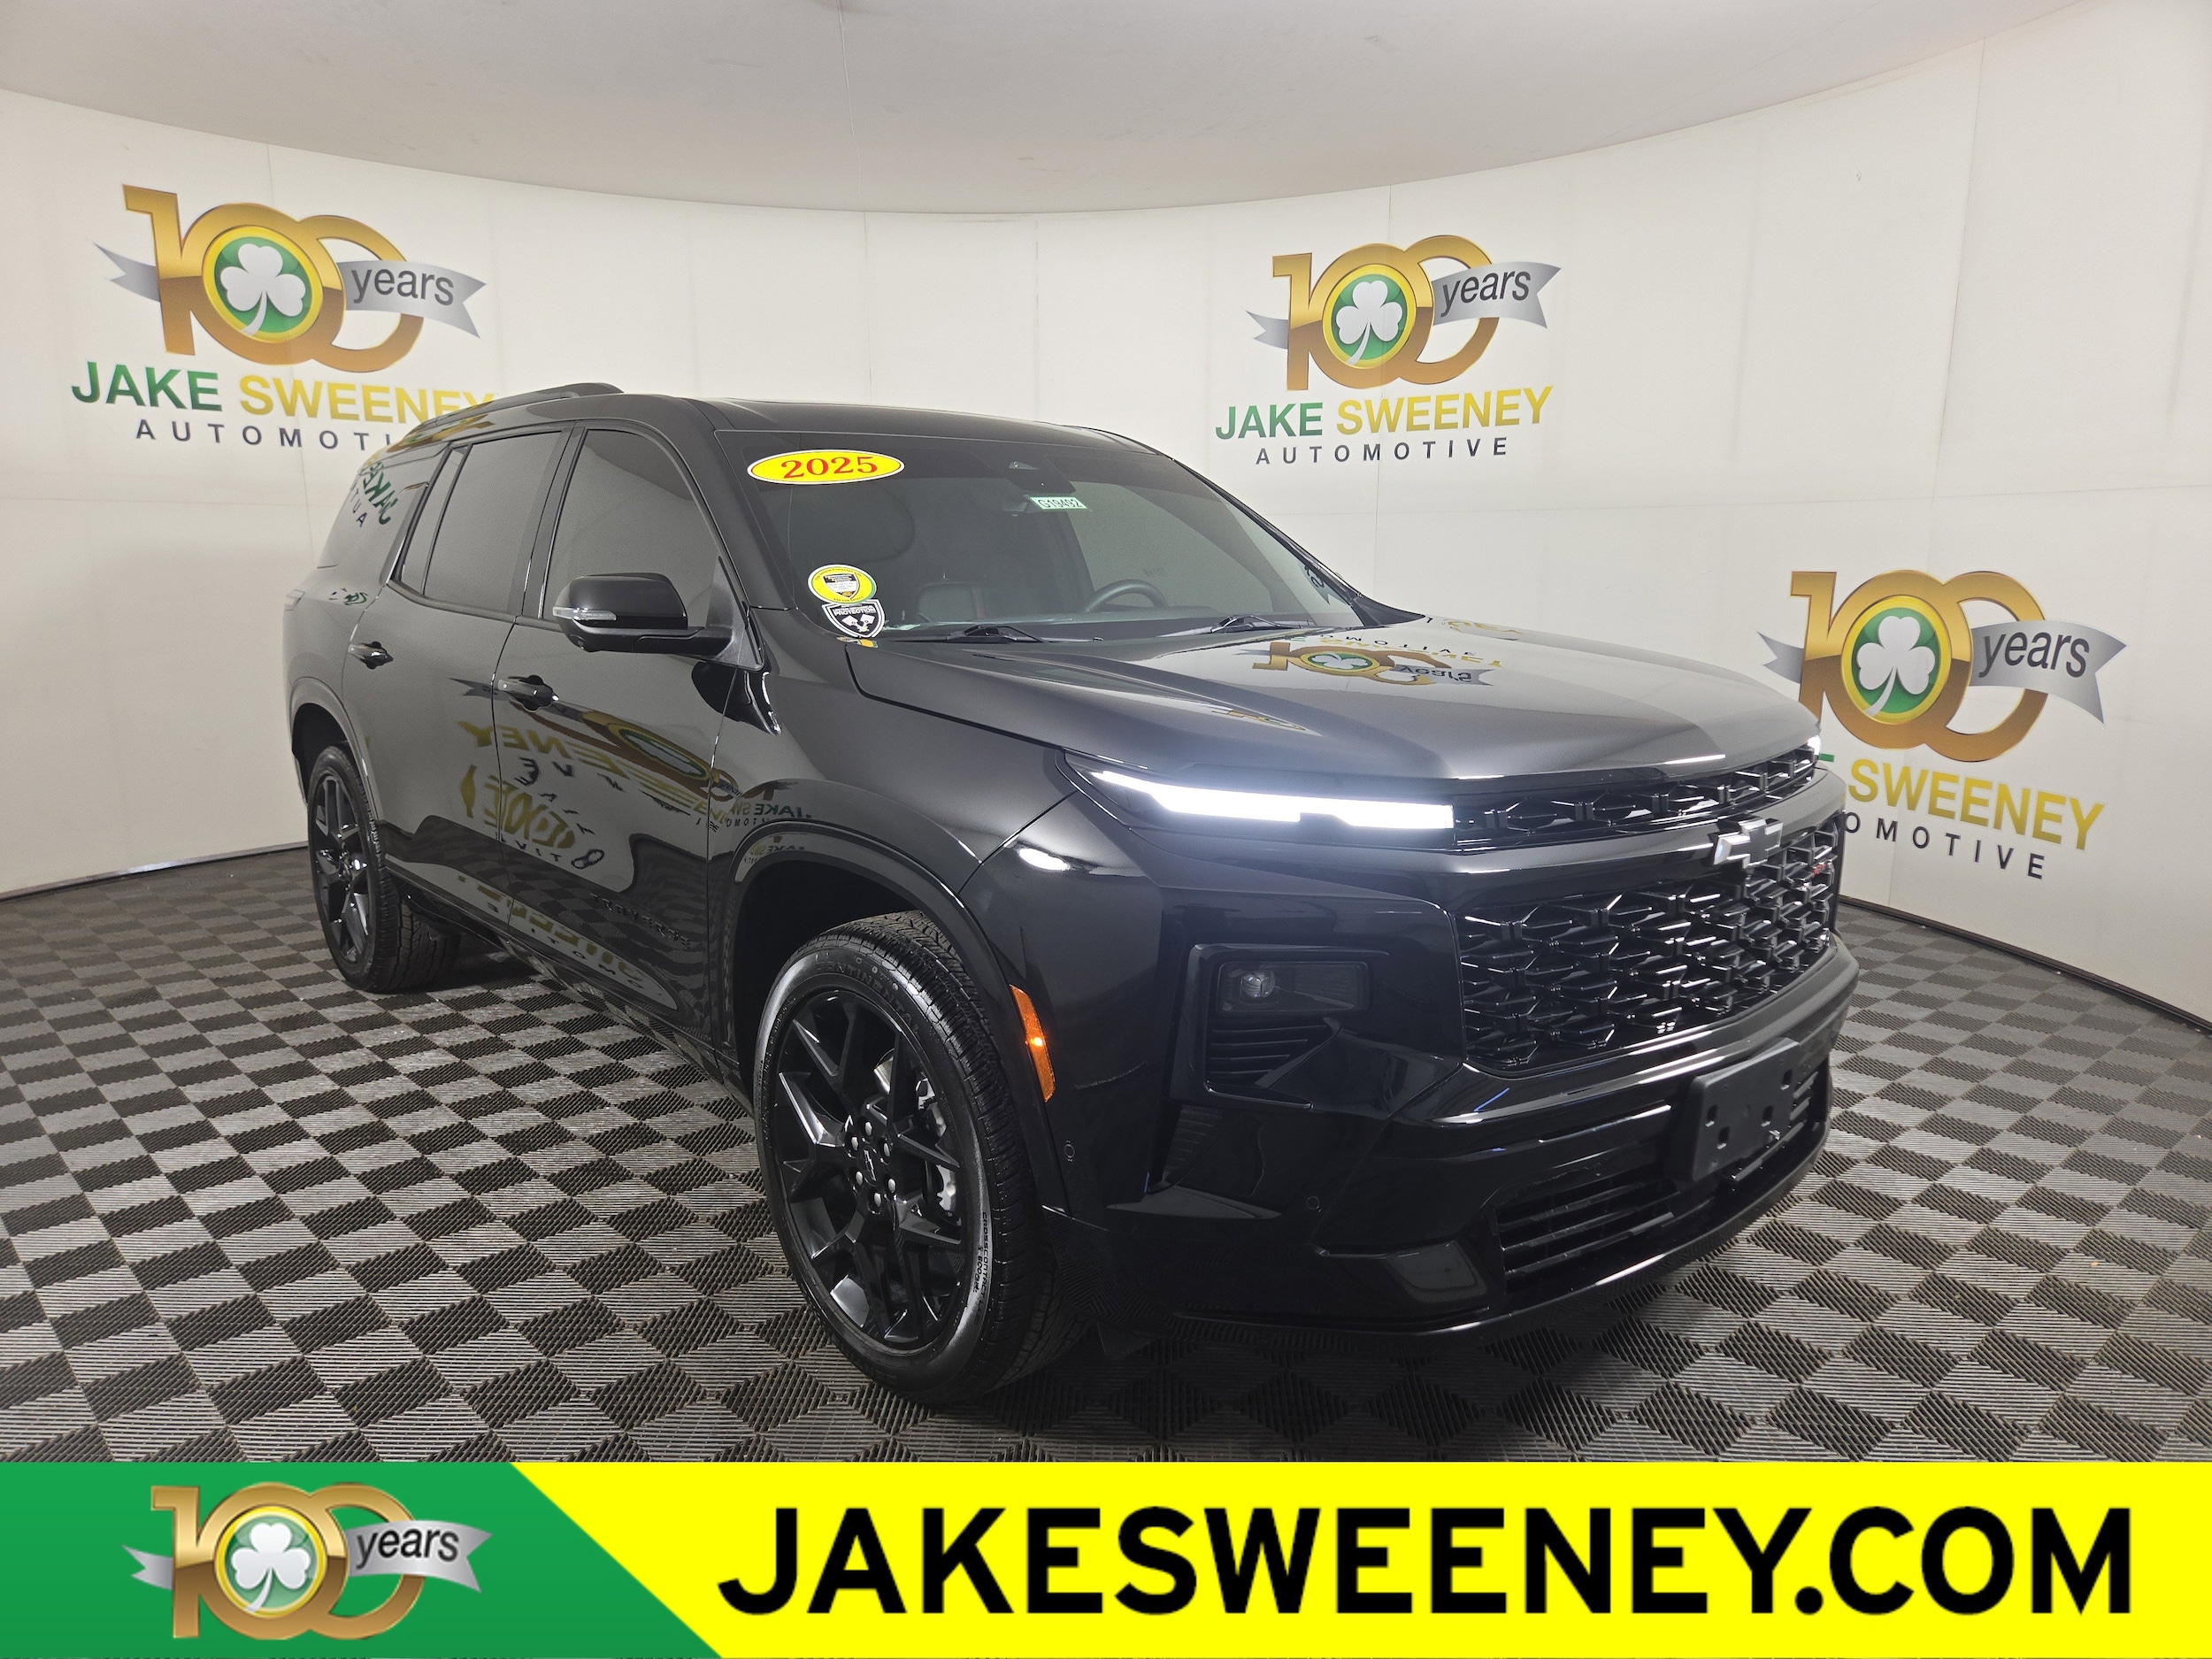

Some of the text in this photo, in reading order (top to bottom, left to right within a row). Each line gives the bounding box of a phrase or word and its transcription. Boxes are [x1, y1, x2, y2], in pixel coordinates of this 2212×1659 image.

[350, 265, 455, 306] years
[1440, 267, 1532, 319] years
[71, 360, 223, 412] JAKE
[135, 418, 392, 451] AUTOMOTI
[1215, 385, 1555, 441] JAKE SWEENEY
[780, 456, 879, 480] 2025
[1255, 436, 1508, 466] AUTOMOTIVE
[832, 607, 877, 617] PROTECTION
[1977, 631, 2091, 679] years
[1847, 757, 2105, 851] SWEENEY
[1845, 811, 2046, 880] OMOTIVE
[979, 1211, 989, 1299] CROSSCONTACT
